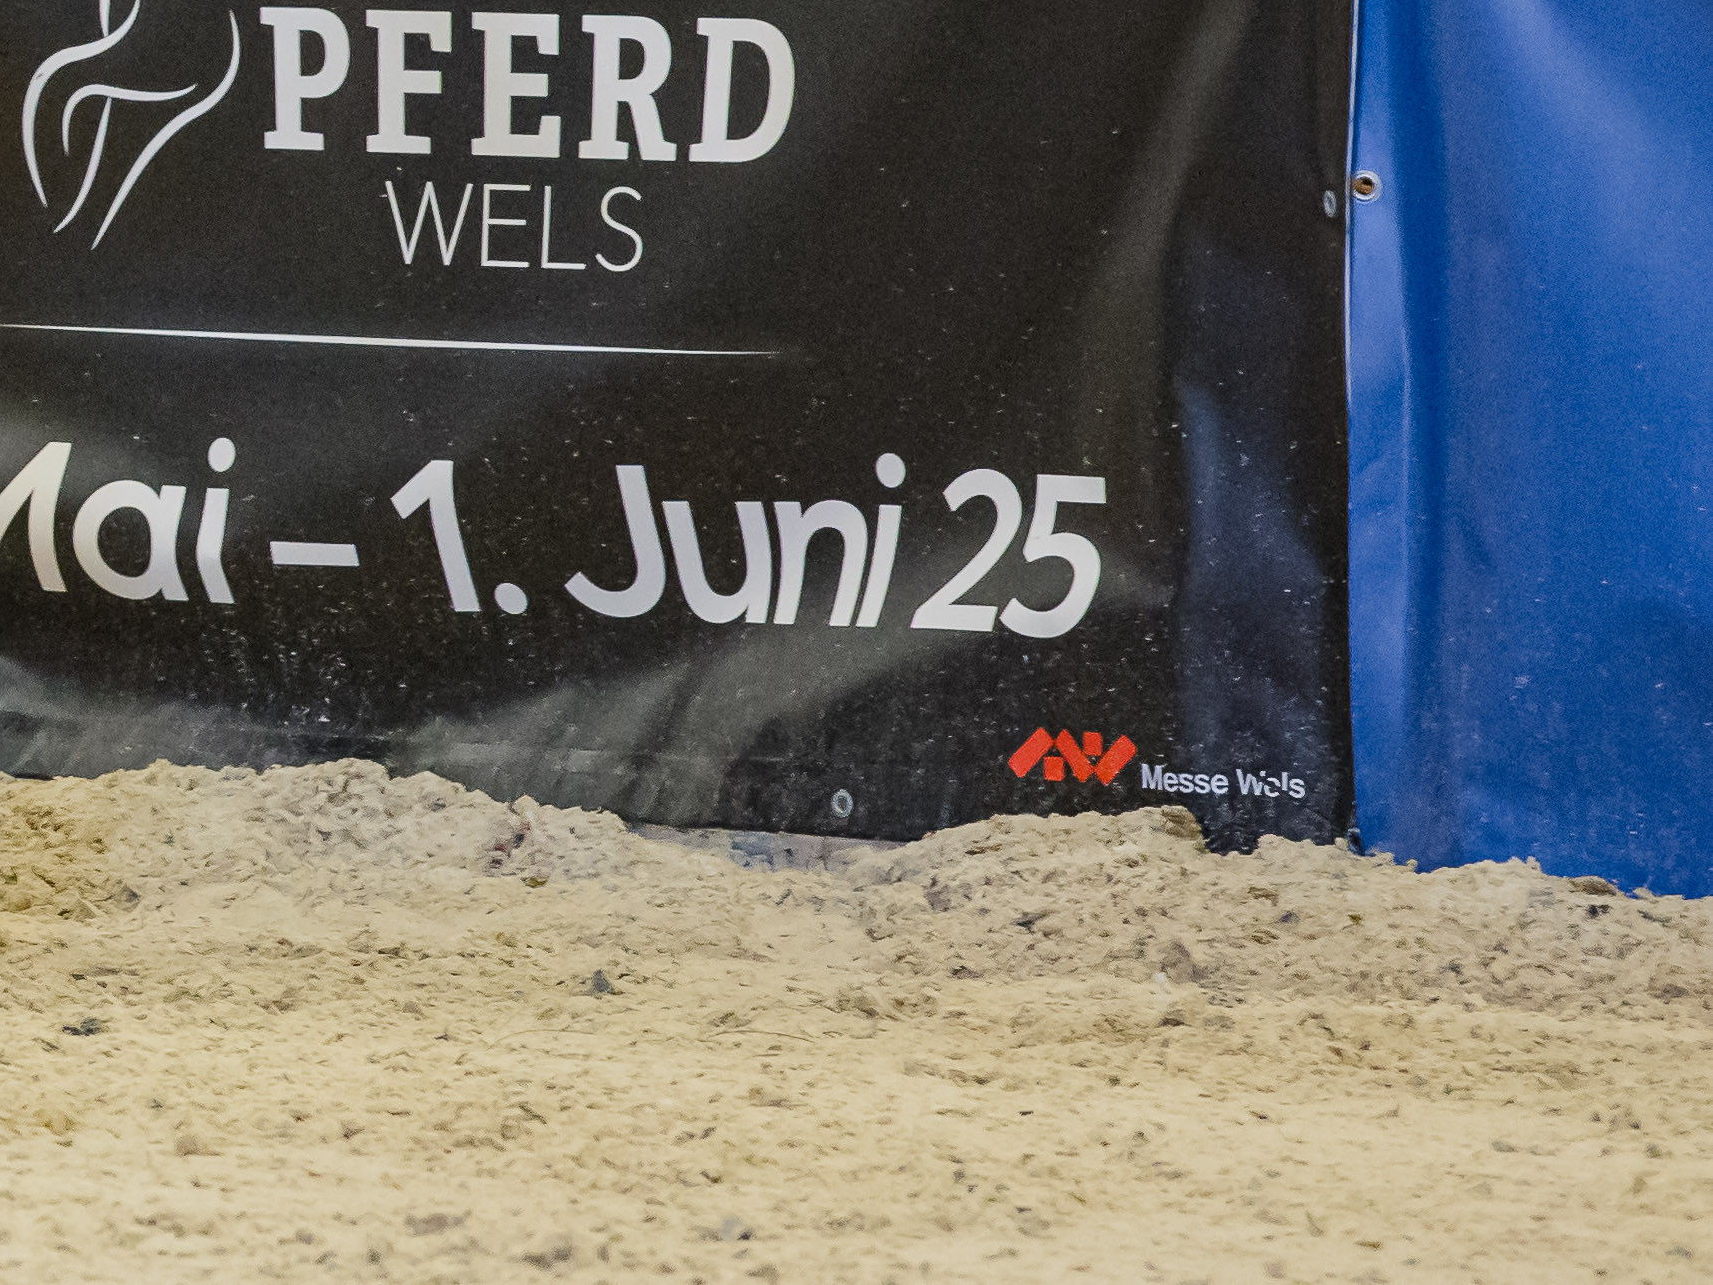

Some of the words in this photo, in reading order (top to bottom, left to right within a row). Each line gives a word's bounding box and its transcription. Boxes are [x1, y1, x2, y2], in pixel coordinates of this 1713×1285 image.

[259, 5, 796, 165] PFERD
[384, 179, 644, 273] WELS
[390, 459, 528, 615] 1.
[563, 452, 907, 628] Juni
[910, 467, 1107, 639] 25
[1141, 763, 1229, 795] Messe
